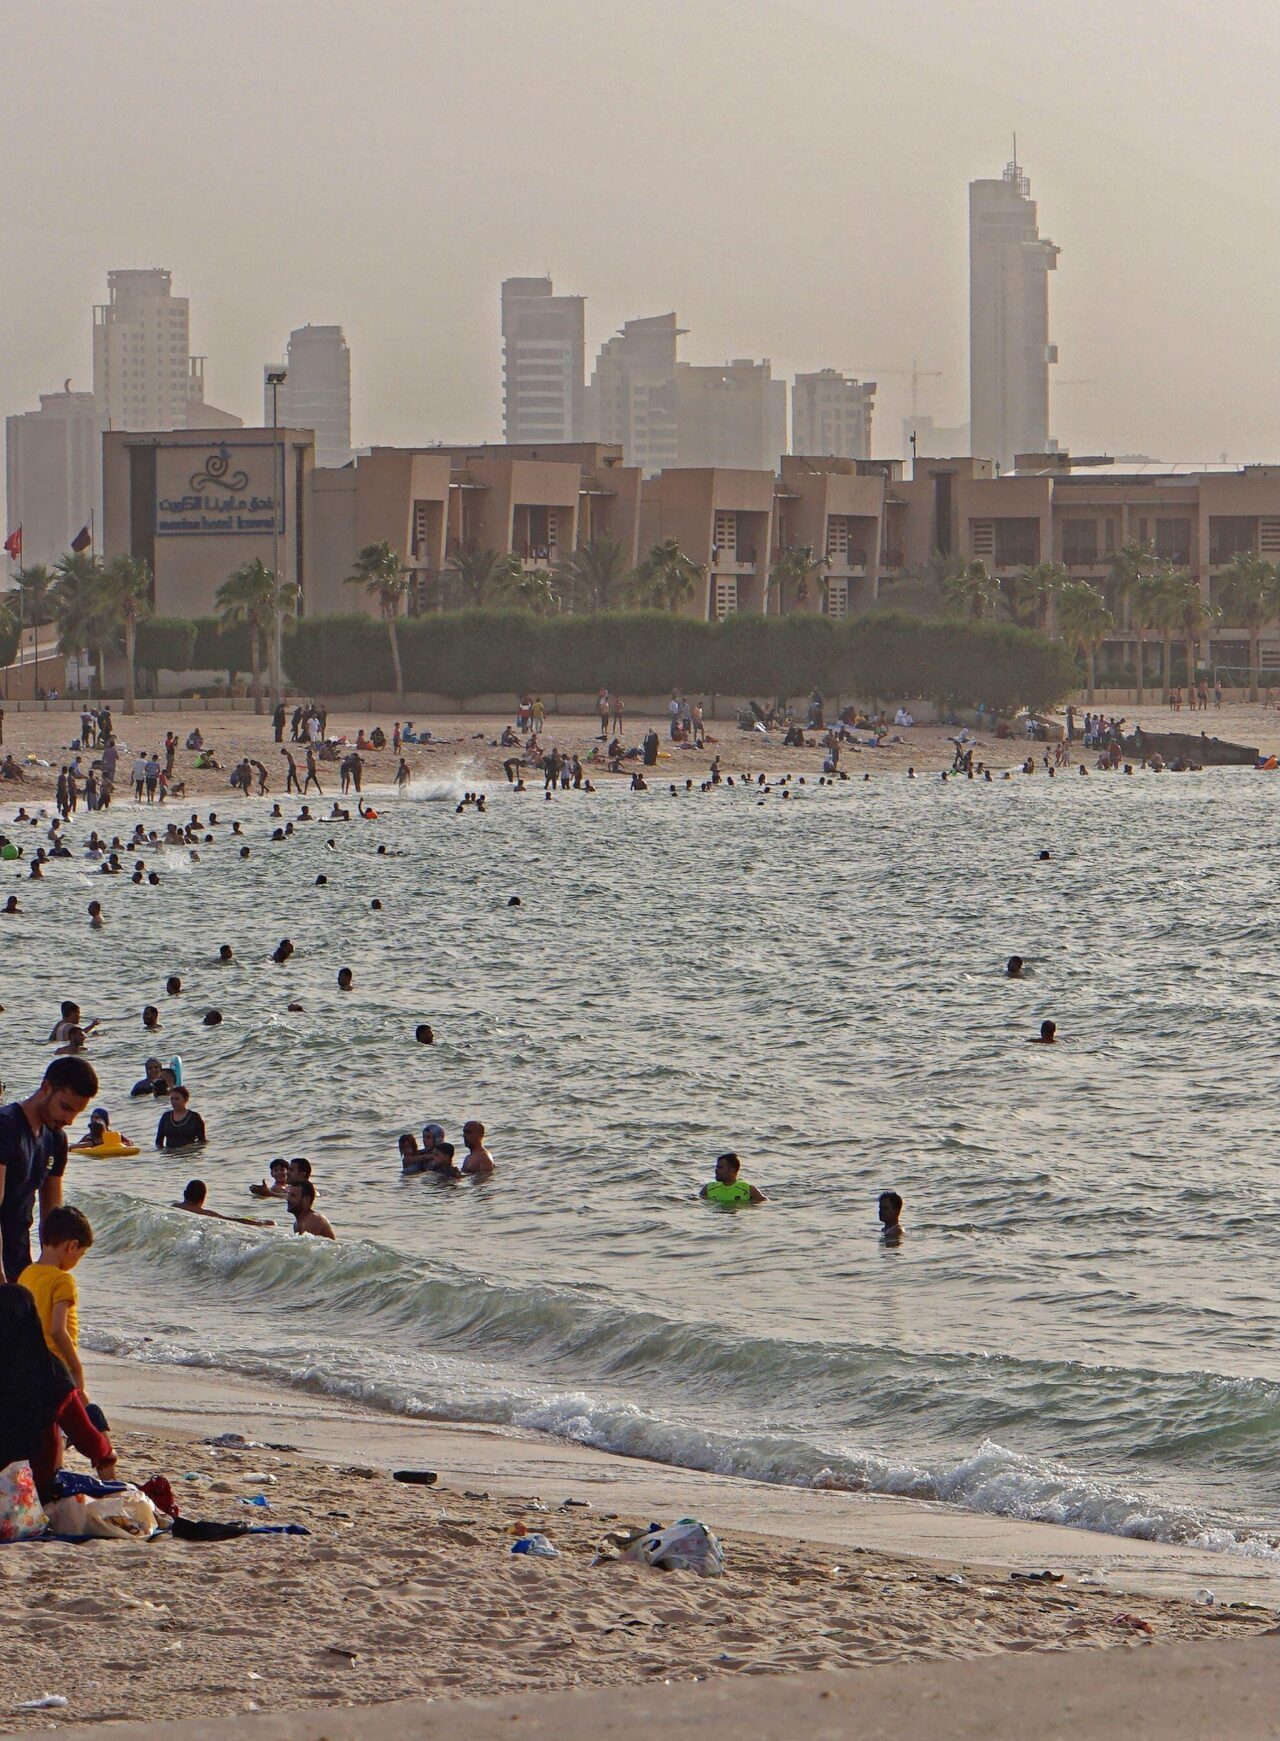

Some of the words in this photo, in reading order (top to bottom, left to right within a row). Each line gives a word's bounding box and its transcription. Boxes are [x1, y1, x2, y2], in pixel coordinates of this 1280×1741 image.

[159, 496, 201, 512] الكويت
[159, 518, 200, 530] marina
[201, 515, 233, 530] hotel
